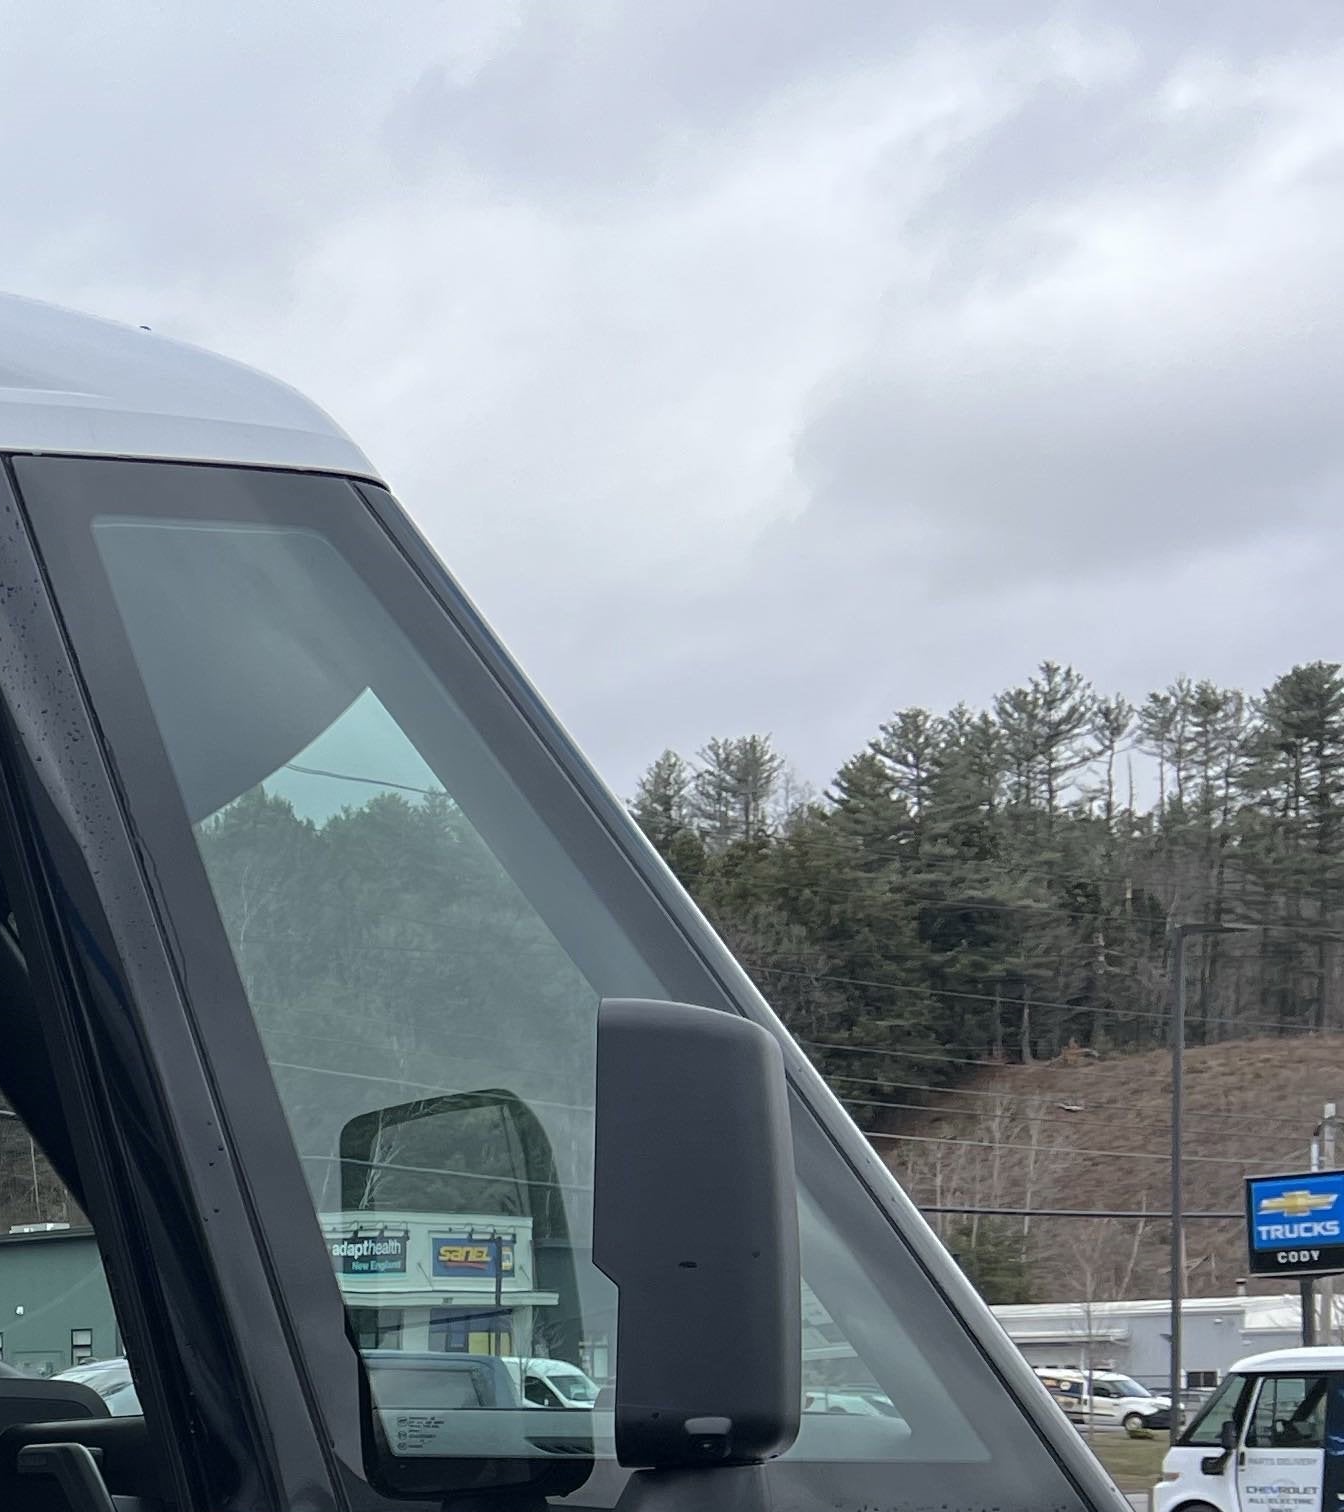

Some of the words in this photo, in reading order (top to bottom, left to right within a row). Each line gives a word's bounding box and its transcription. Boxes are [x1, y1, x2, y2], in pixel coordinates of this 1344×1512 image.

[1257, 1220, 1340, 1240] TRUCKS
[332, 1239, 401, 1259] adapthealth
[1277, 1250, 1320, 1264] CODY
[351, 1261, 369, 1271] New
[370, 1260, 401, 1272] England
[1246, 1486, 1317, 1494] CHEVROLET
